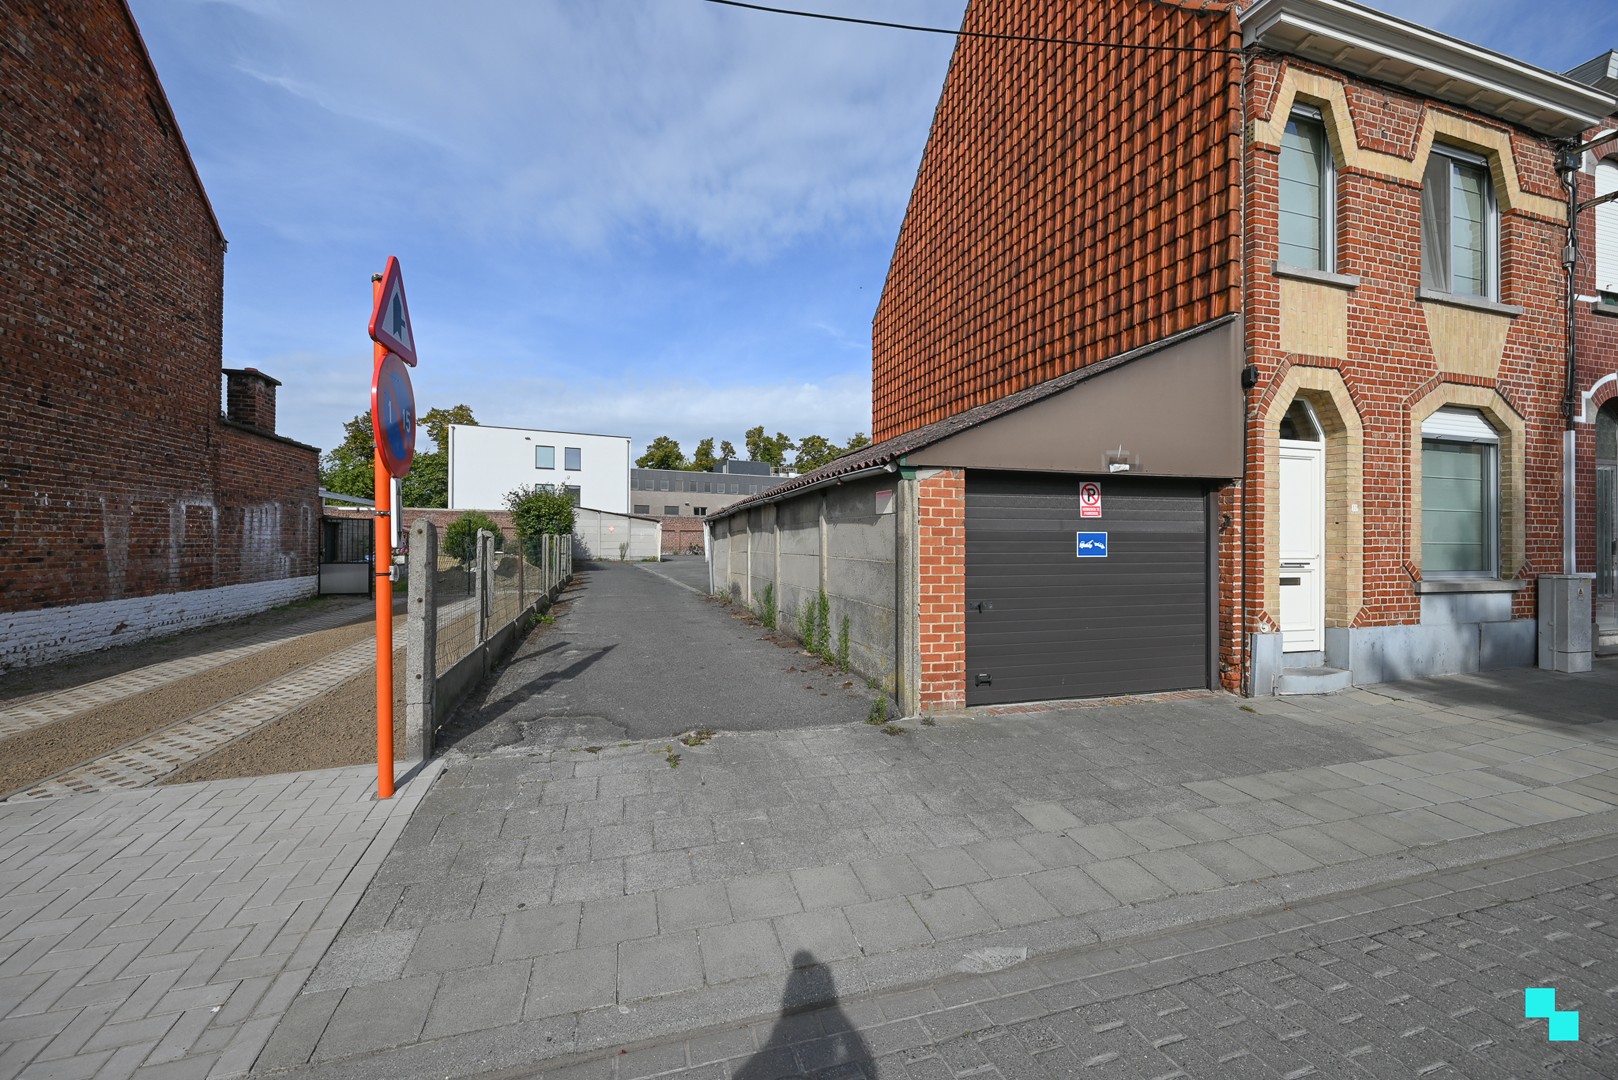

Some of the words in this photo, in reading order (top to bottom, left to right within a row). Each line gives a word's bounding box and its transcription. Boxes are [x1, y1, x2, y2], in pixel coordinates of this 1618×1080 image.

[388, 400, 392, 423] 1
[402, 408, 410, 432] 15
[1088, 488, 1096, 502] P
